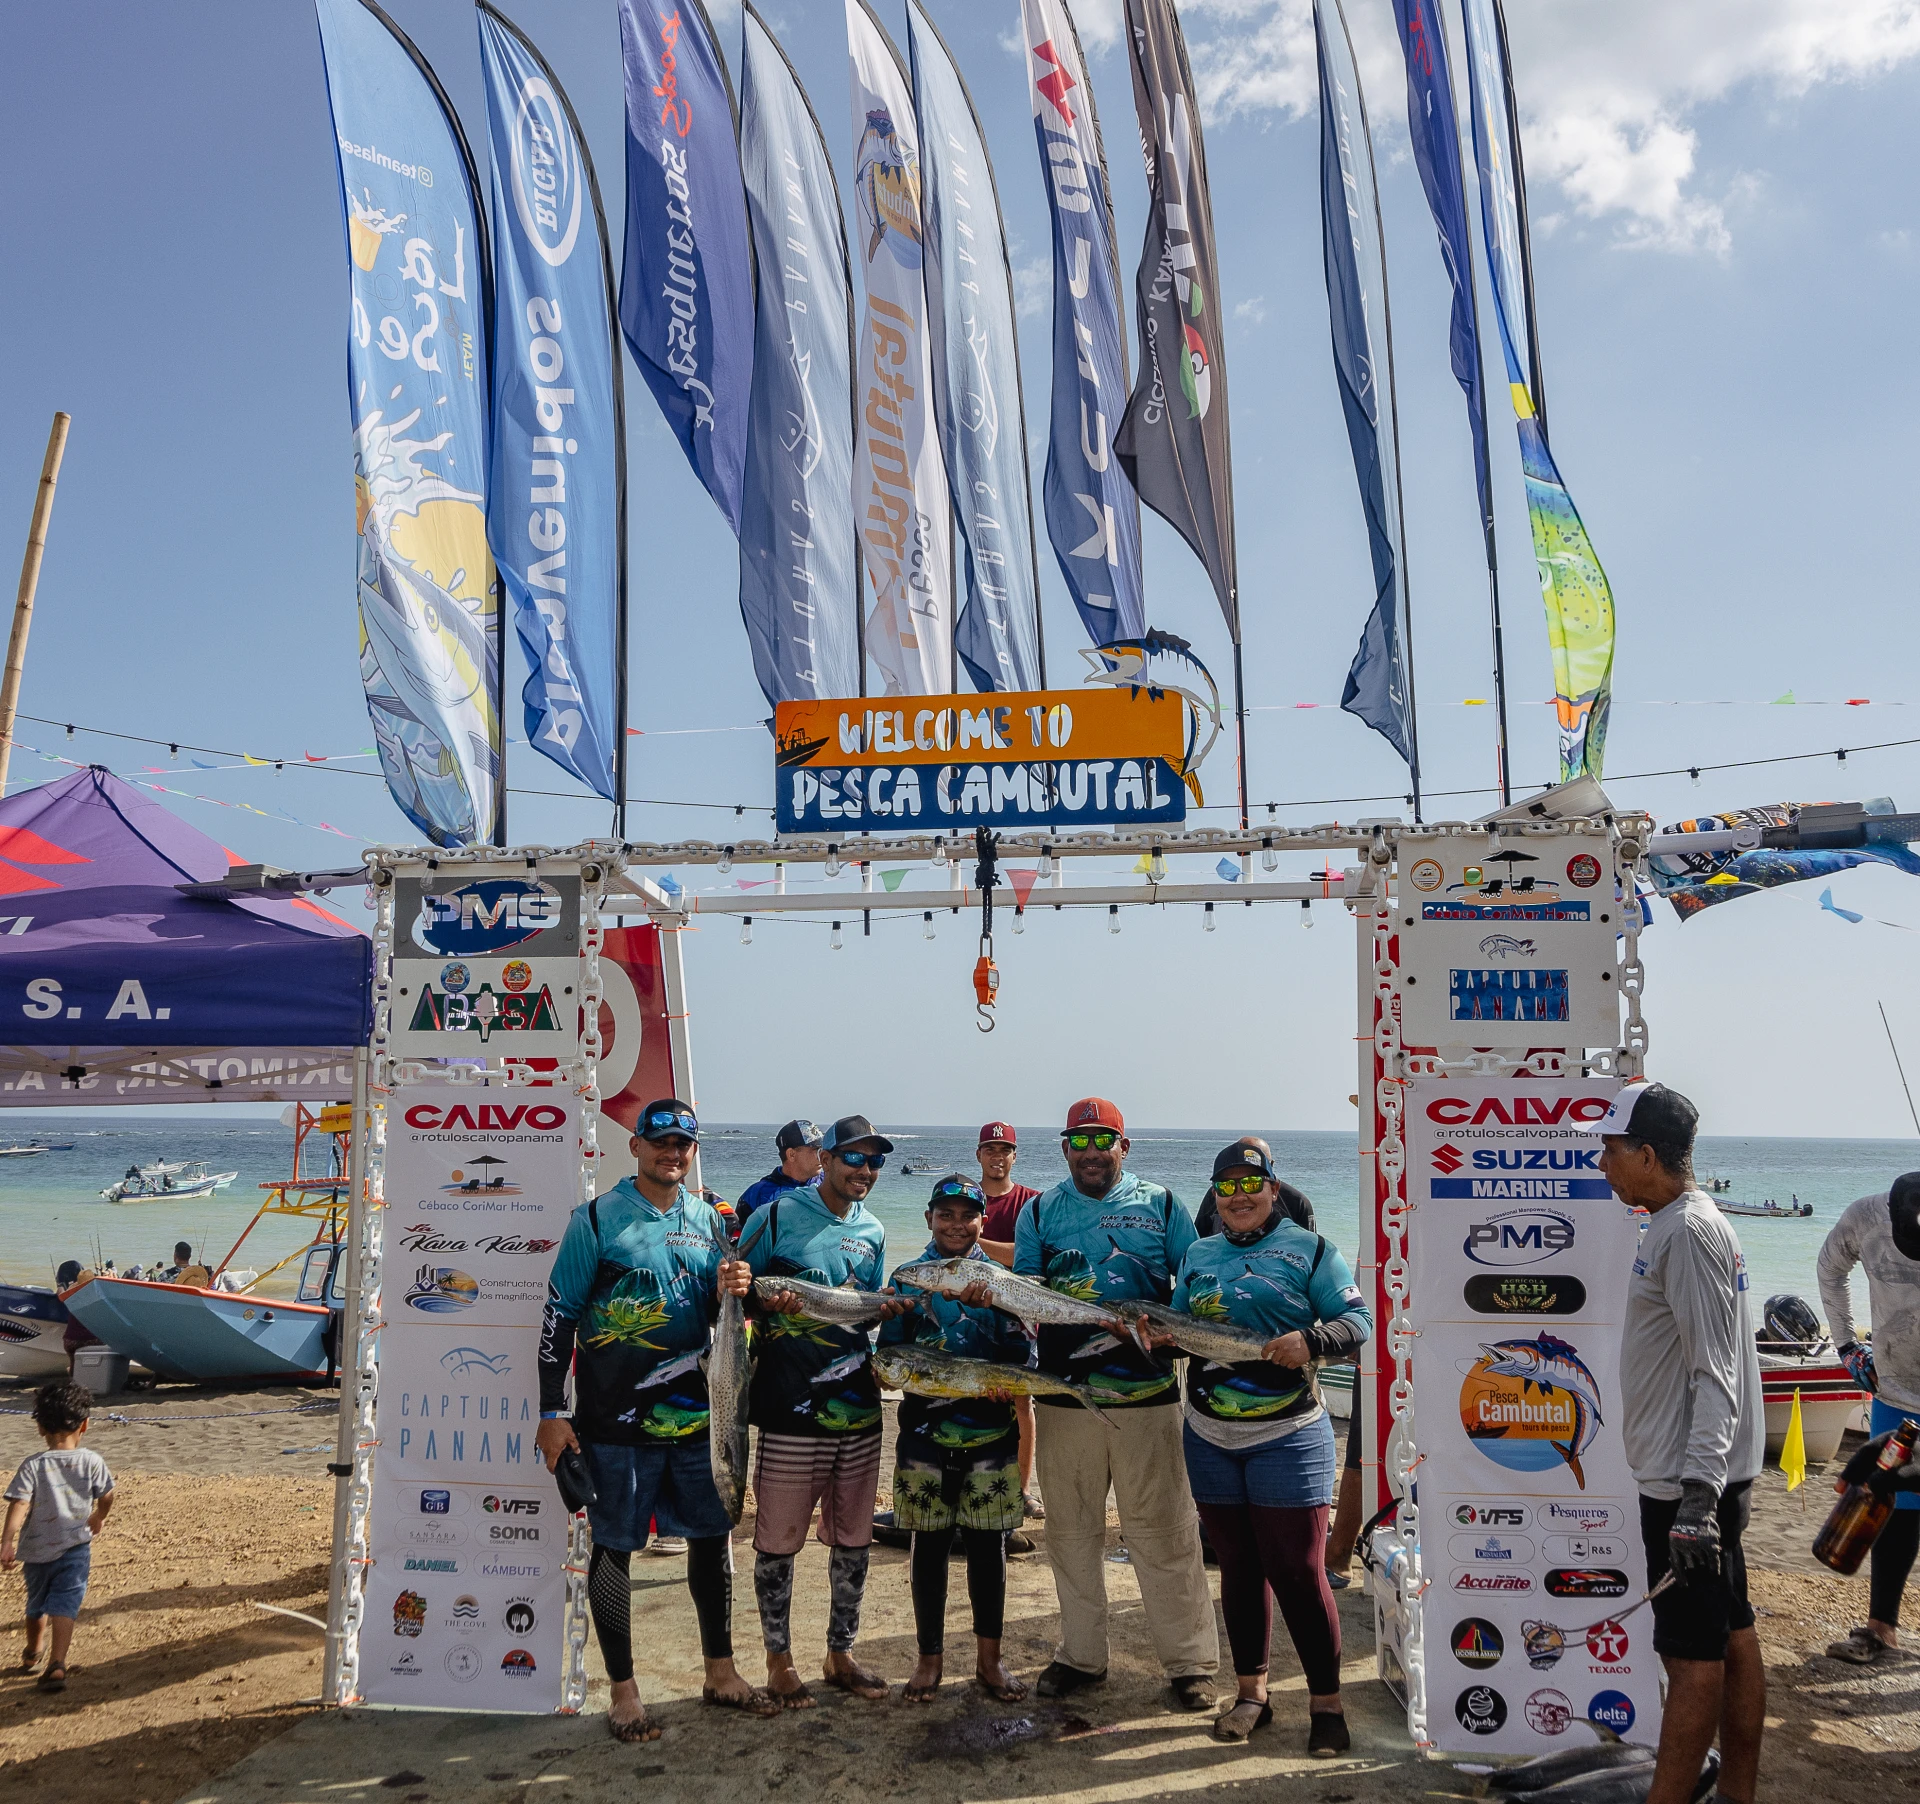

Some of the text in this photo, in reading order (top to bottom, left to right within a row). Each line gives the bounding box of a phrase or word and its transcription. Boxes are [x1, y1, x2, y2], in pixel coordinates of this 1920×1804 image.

[838, 703, 1073, 755] WELCOME TO
[792, 758, 1172, 820] PESCA CAMBUTAL
[1422, 905, 1589, 921] Cébaco CoriMar Home
[1450, 970, 1568, 990] CAPTURAS
[22, 978, 172, 1021] S. A.
[404, 1104, 567, 1131] CALVO
[1425, 1097, 1613, 1125] CALVO
[408, 1132, 564, 1145] @rotuloscalvopanama
[1472, 1149, 1603, 1171] SUZUK
[1471, 1180, 1570, 1198] MARINE
[418, 1199, 545, 1213] Cébaco CoriMar Home
[399, 1233, 470, 1255] Kava
[1469, 1224, 1575, 1249] PMS
[479, 1278, 544, 1288] Constructora
[1500, 1284, 1548, 1296] H&H
[479, 1291, 545, 1302] los magníficos
[1489, 1390, 1519, 1404] Pesca
[402, 1392, 531, 1421] CAPTURA
[1478, 1399, 1571, 1424] Cambutal
[1522, 1423, 1570, 1433] tours de pesca
[502, 1498, 541, 1516] VFS
[1549, 1503, 1609, 1520] Pesqueros
[1478, 1508, 1524, 1525] VFS
[490, 1525, 540, 1541] sona
[1579, 1519, 1610, 1533] Sport
[409, 1531, 457, 1540] SANSARA
[1591, 1546, 1613, 1555] R&S
[403, 1558, 459, 1573] DANIEL
[482, 1564, 541, 1577] KAMBUTE
[1454, 1573, 1532, 1590] Accurate
[1554, 1585, 1626, 1595] FULL AUTO
[443, 1618, 488, 1629] THE COVE
[505, 1669, 533, 1679] MARINE
[1588, 1665, 1632, 1675] TEXACO
[1594, 1708, 1629, 1721] delta
